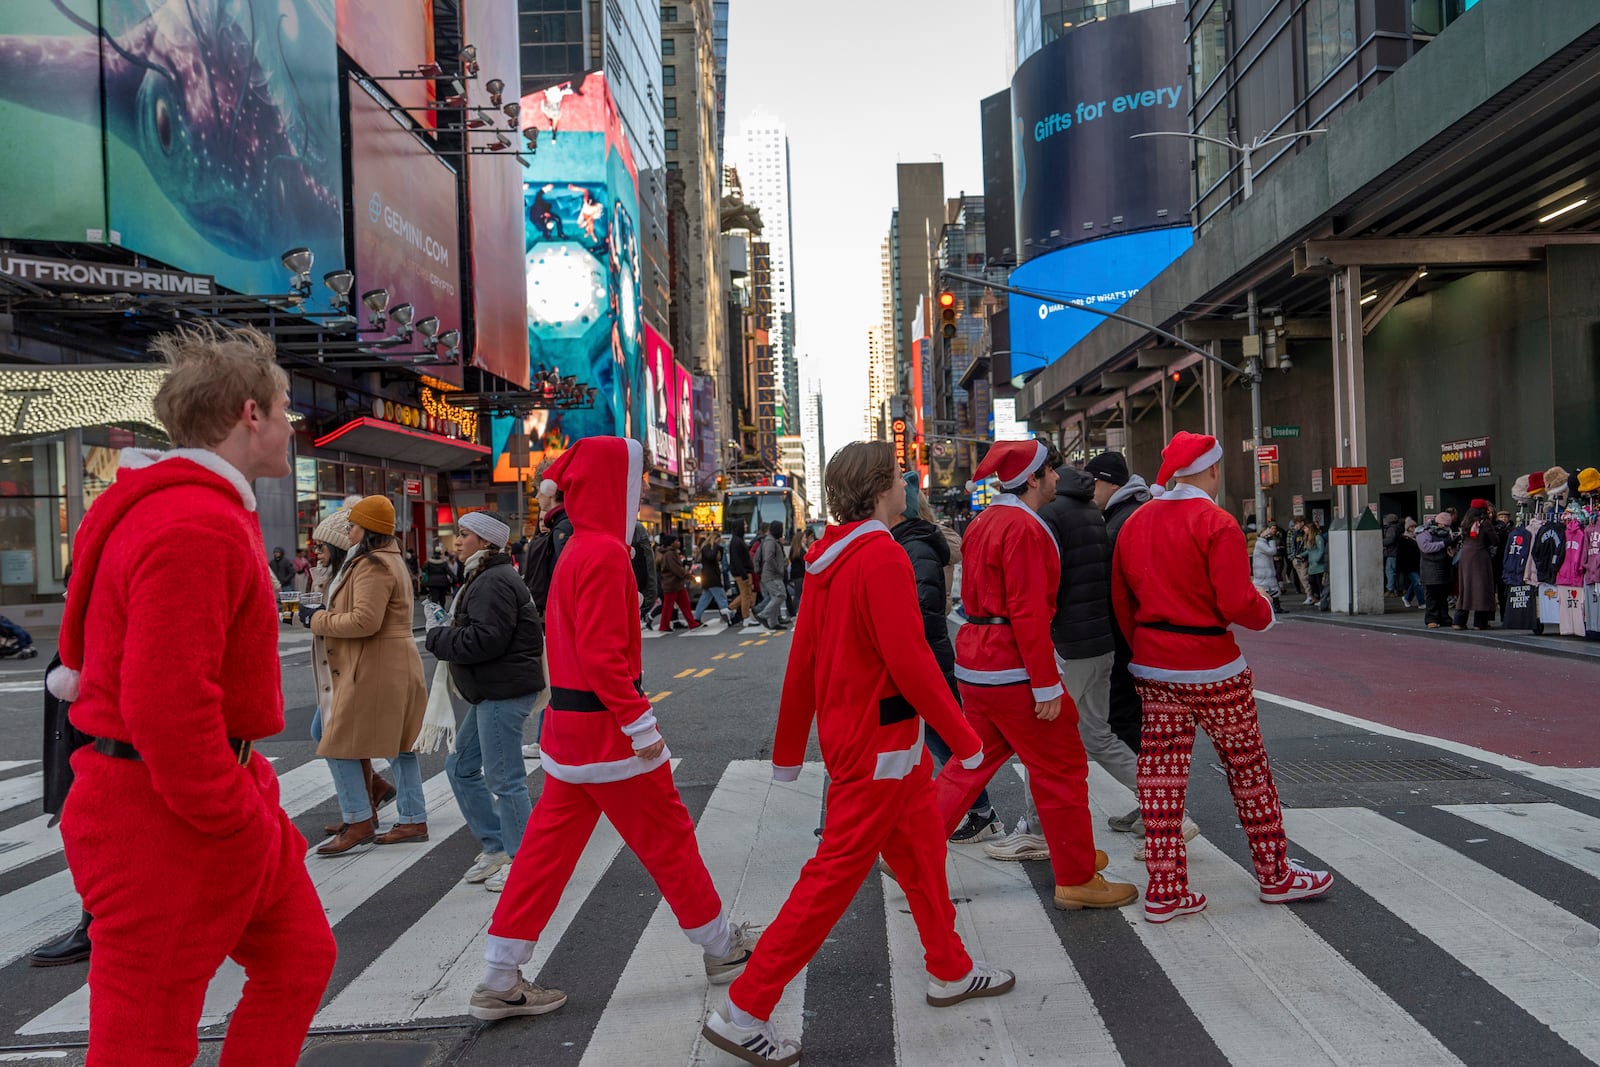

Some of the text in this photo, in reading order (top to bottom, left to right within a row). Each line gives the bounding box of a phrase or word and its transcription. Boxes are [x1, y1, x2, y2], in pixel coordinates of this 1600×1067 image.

[1034, 85, 1183, 142] Gifts for every
[384, 205, 449, 268] GEMINI.COM
[430, 272, 455, 296] CRYPTO
[1086, 296, 1096, 305] OF
[1097, 290, 1127, 303] WHAT'S
[1272, 427, 1300, 438] Broadway
[895, 434, 906, 472] REGA
[1509, 545, 1523, 555] NY
[1567, 600, 1579, 609] NY
